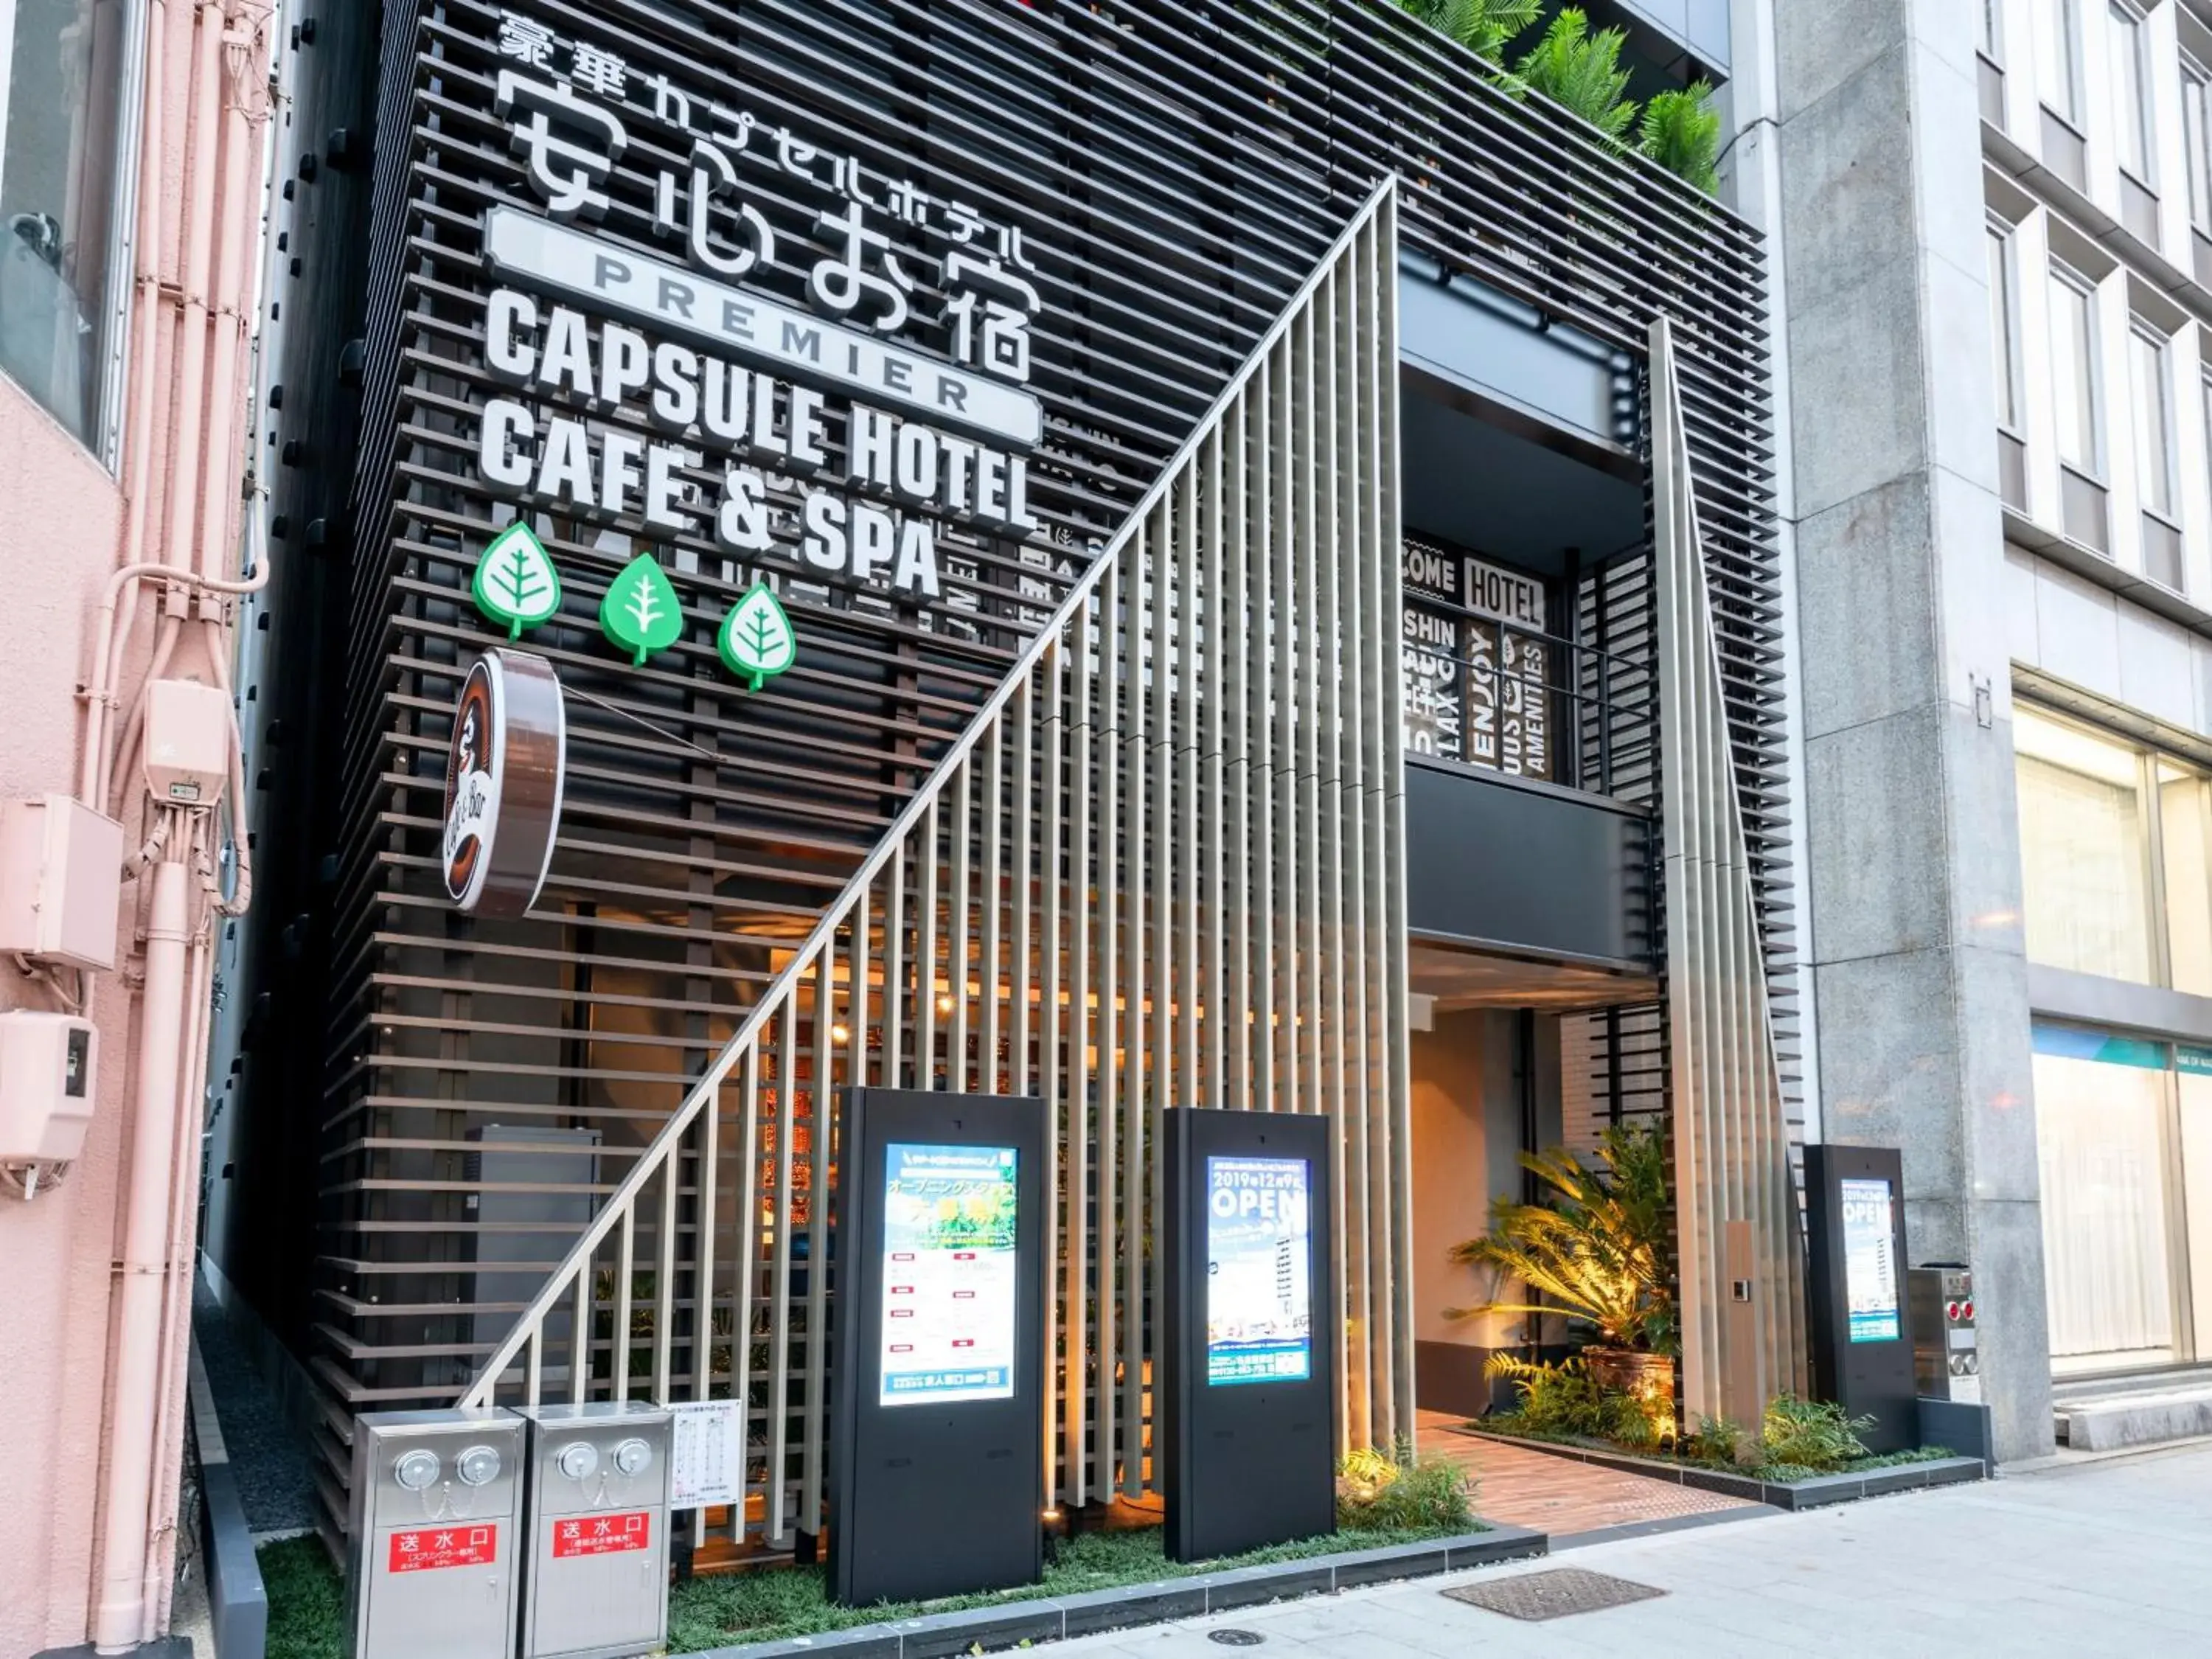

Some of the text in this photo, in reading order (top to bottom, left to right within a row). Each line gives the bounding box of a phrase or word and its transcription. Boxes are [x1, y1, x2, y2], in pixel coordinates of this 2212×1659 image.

[496, 10, 1036, 272] 豪華カプセルホテル
[494, 69, 1041, 385] 安心お宿
[593, 252, 969, 414] PREMIER
[485, 288, 1037, 531] CAPSULE HOTEL
[480, 398, 686, 531] CAFE
[719, 469, 776, 552] &
[804, 492, 940, 599] SPA
[1472, 565, 1542, 627] HOTEL
[1472, 628, 1496, 759] ENJOY
[1524, 644, 1545, 773] AMENITIES
[1211, 1188, 1307, 1219] OPEN
[399, 1528, 488, 1553] 送水口
[563, 1516, 641, 1539] 送水口
